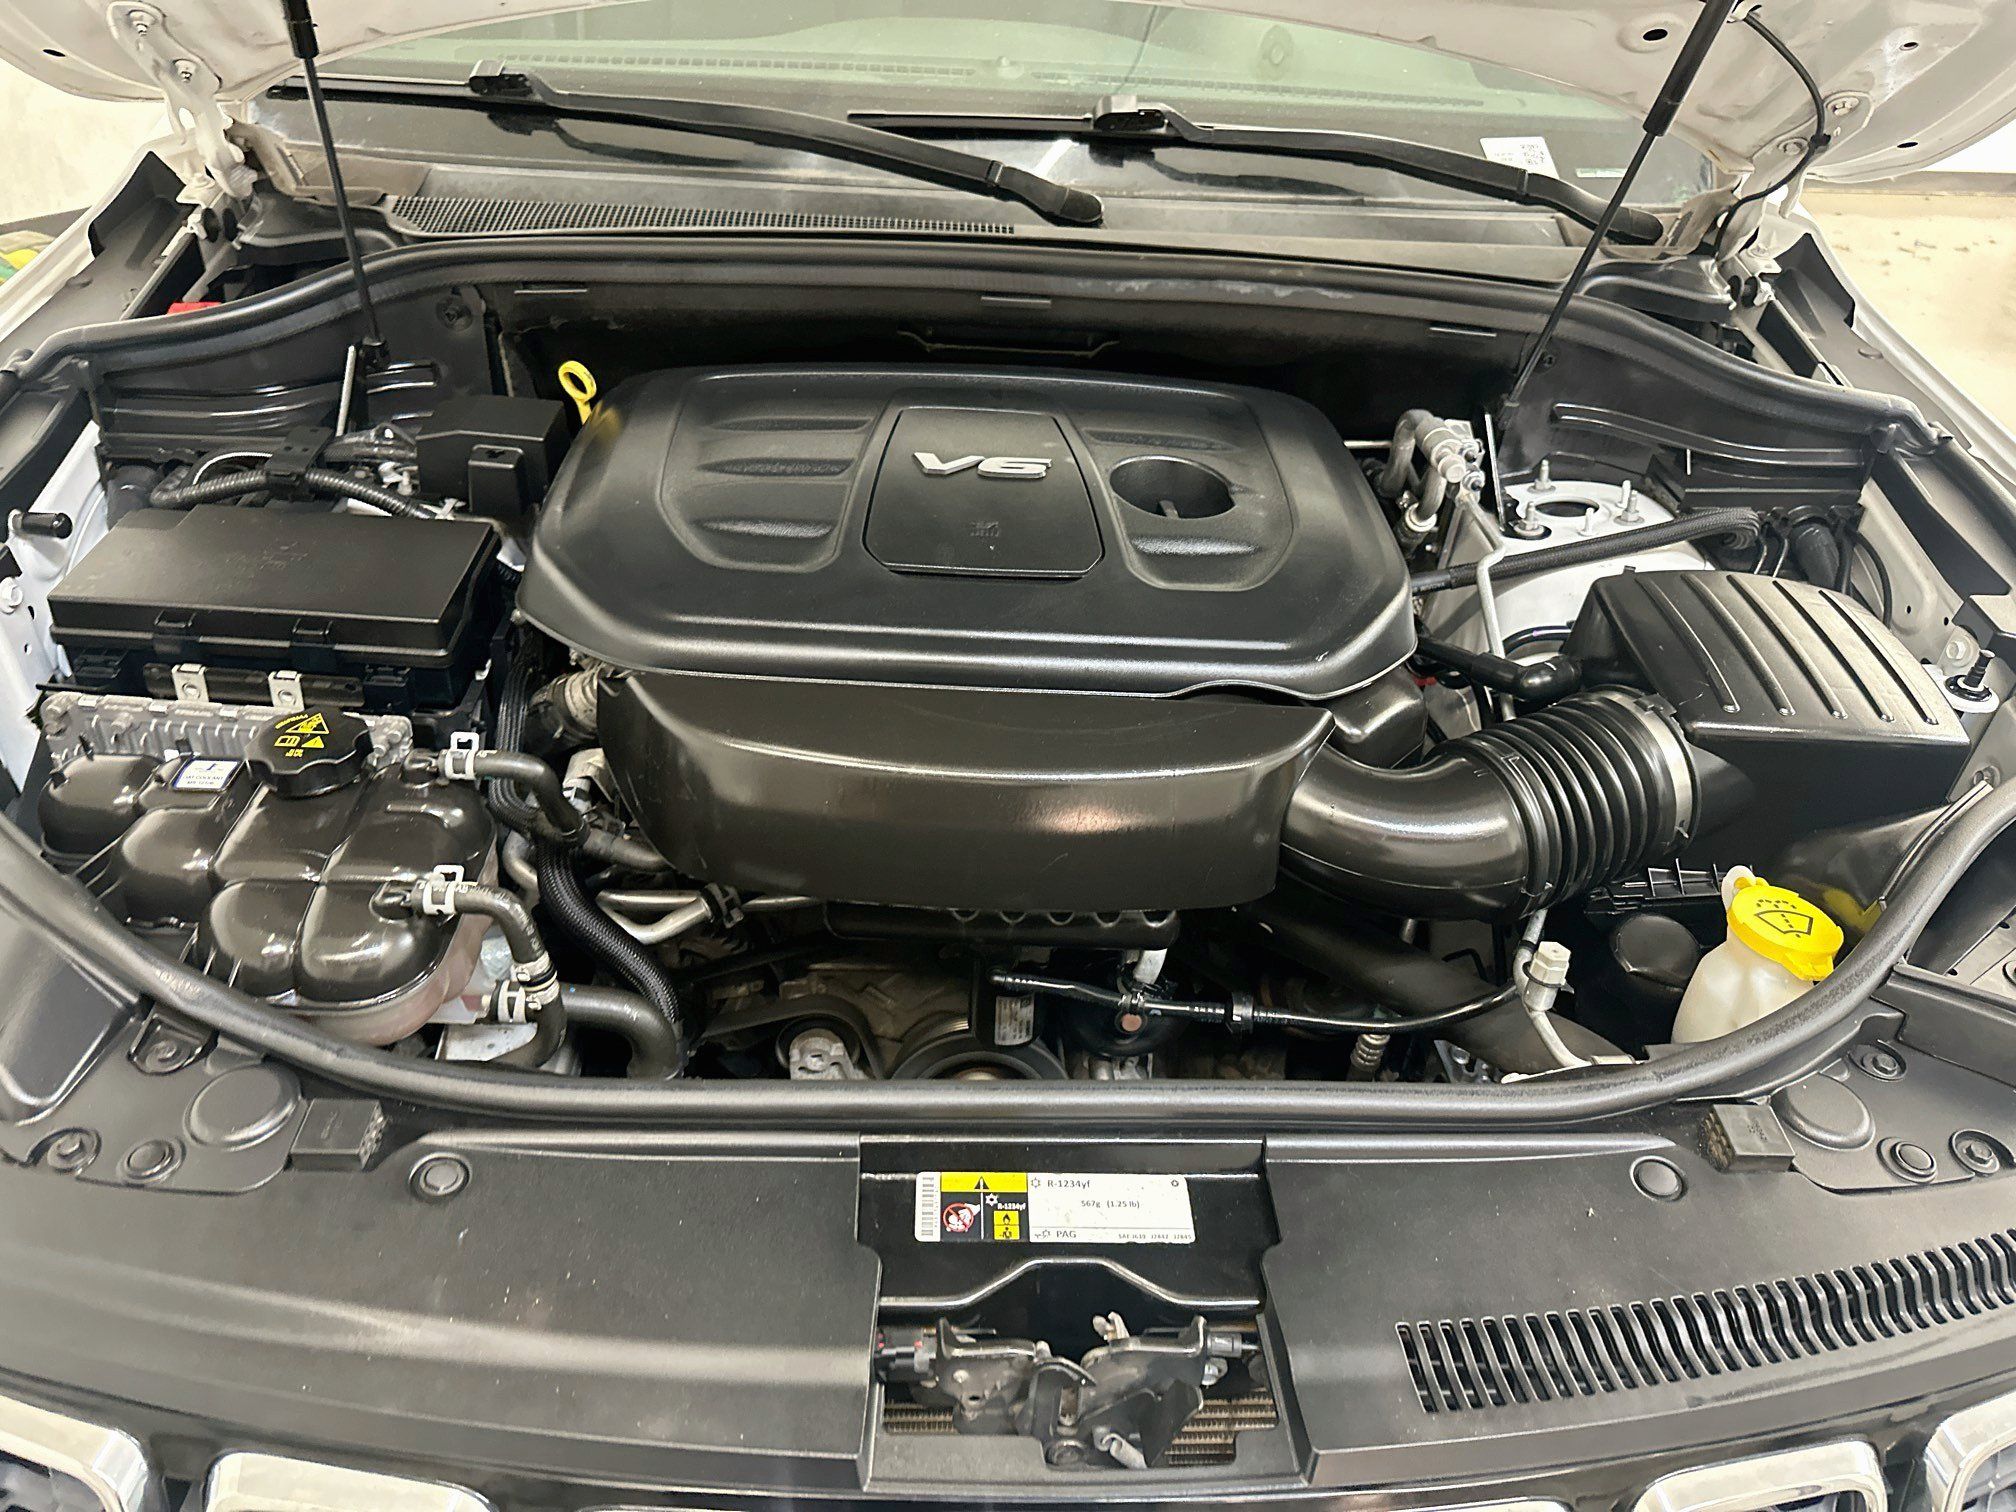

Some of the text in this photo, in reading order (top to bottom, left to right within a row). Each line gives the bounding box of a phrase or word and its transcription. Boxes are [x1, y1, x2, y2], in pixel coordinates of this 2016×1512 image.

[913, 452, 1052, 479] V6
[1047, 1179, 1091, 1189] R-1234yf
[1081, 1200, 1140, 1209] 567g (1.25 lb)
[1056, 1230, 1077, 1238] PAG
